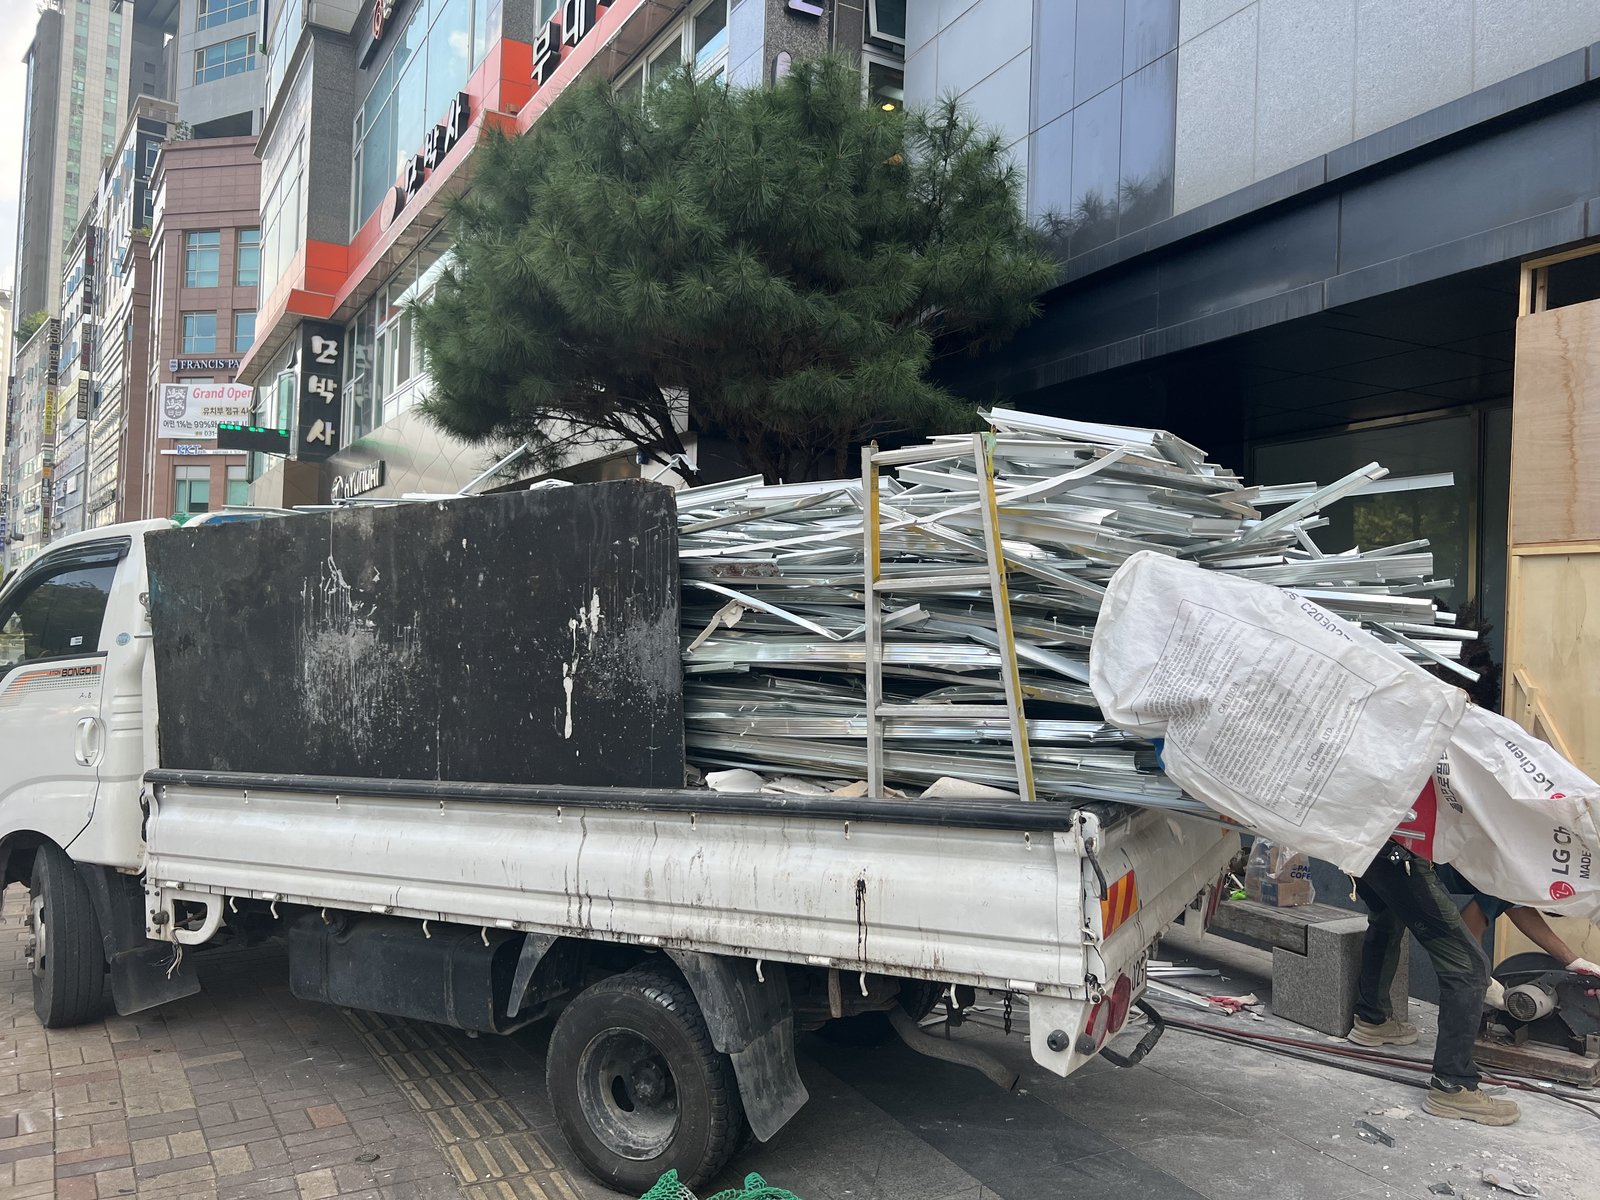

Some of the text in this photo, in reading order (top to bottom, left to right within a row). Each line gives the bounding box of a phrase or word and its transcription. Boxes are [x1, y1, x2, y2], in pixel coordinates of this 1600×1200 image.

[404, 92, 464, 206] 모박사
[50, 319, 60, 343] HOTEL
[181, 359, 225, 369] FRANCIS
[193, 387, 225, 399] Grand
[306, 335, 338, 446] 모박사
[202, 407, 224, 416] 유치부
[225, 407, 239, 416] 정규
[62, 667, 92, 677] BONGO
[1218, 682, 1240, 713] CAUTION
[1533, 772, 1555, 792] LG
[1551, 848, 1571, 876] LG
